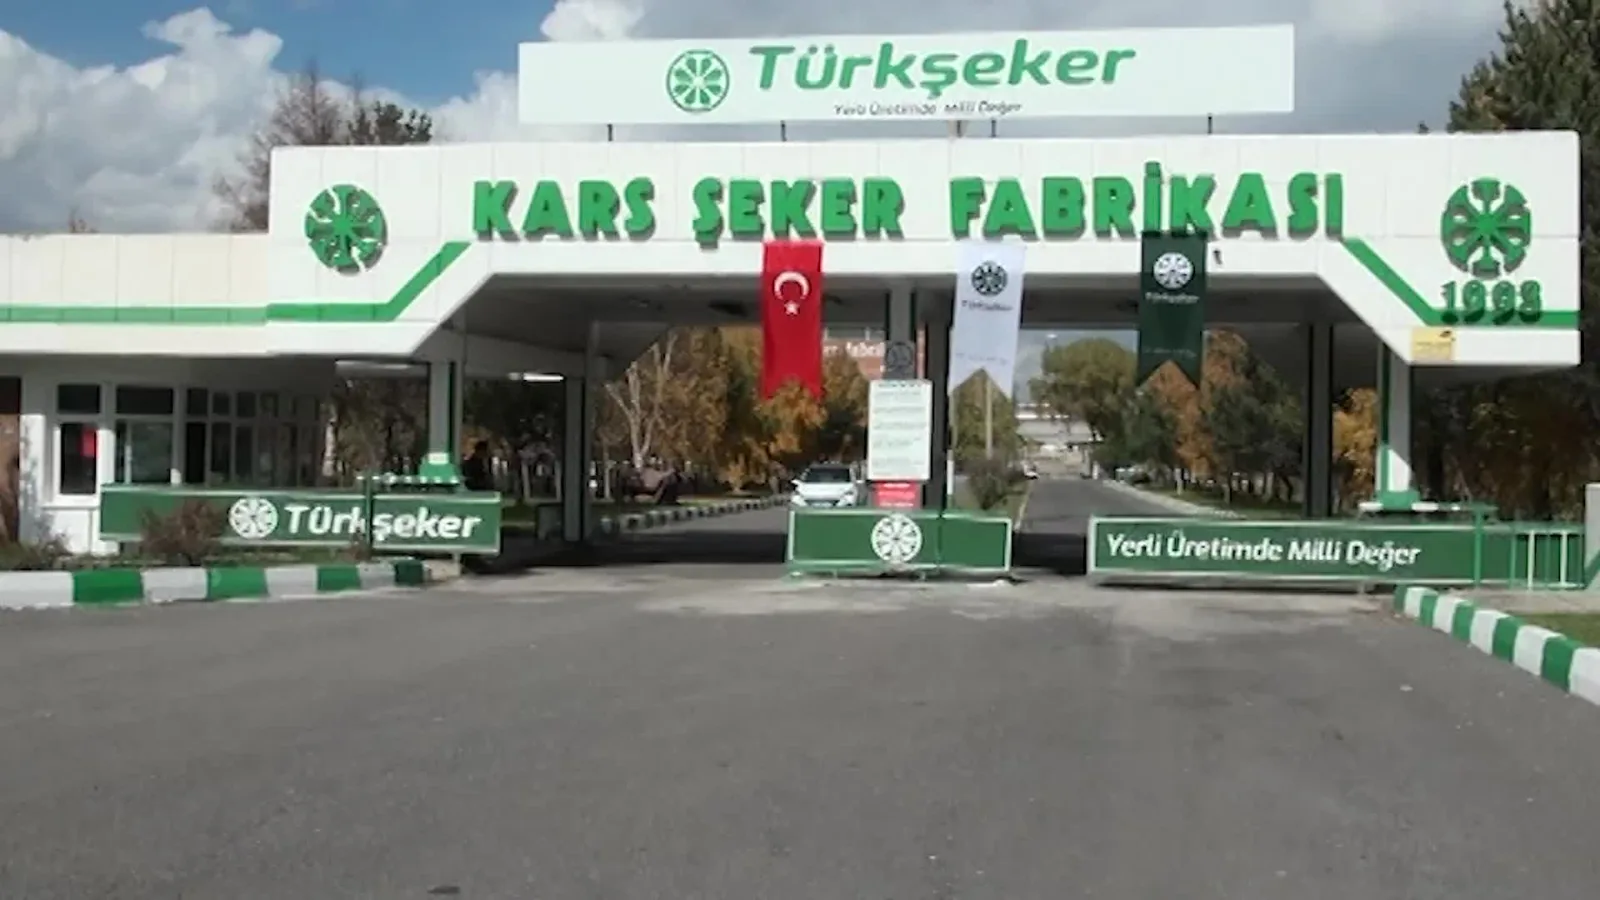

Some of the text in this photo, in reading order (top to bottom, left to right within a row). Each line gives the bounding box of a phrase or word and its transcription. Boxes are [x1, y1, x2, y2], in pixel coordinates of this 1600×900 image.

[749, 38, 1137, 100] Türkşeker
[473, 161, 1344, 249] KARS ŞEKER FABRİKASI
[1106, 529, 1422, 572] Yerli Üretimde Milli Değer
